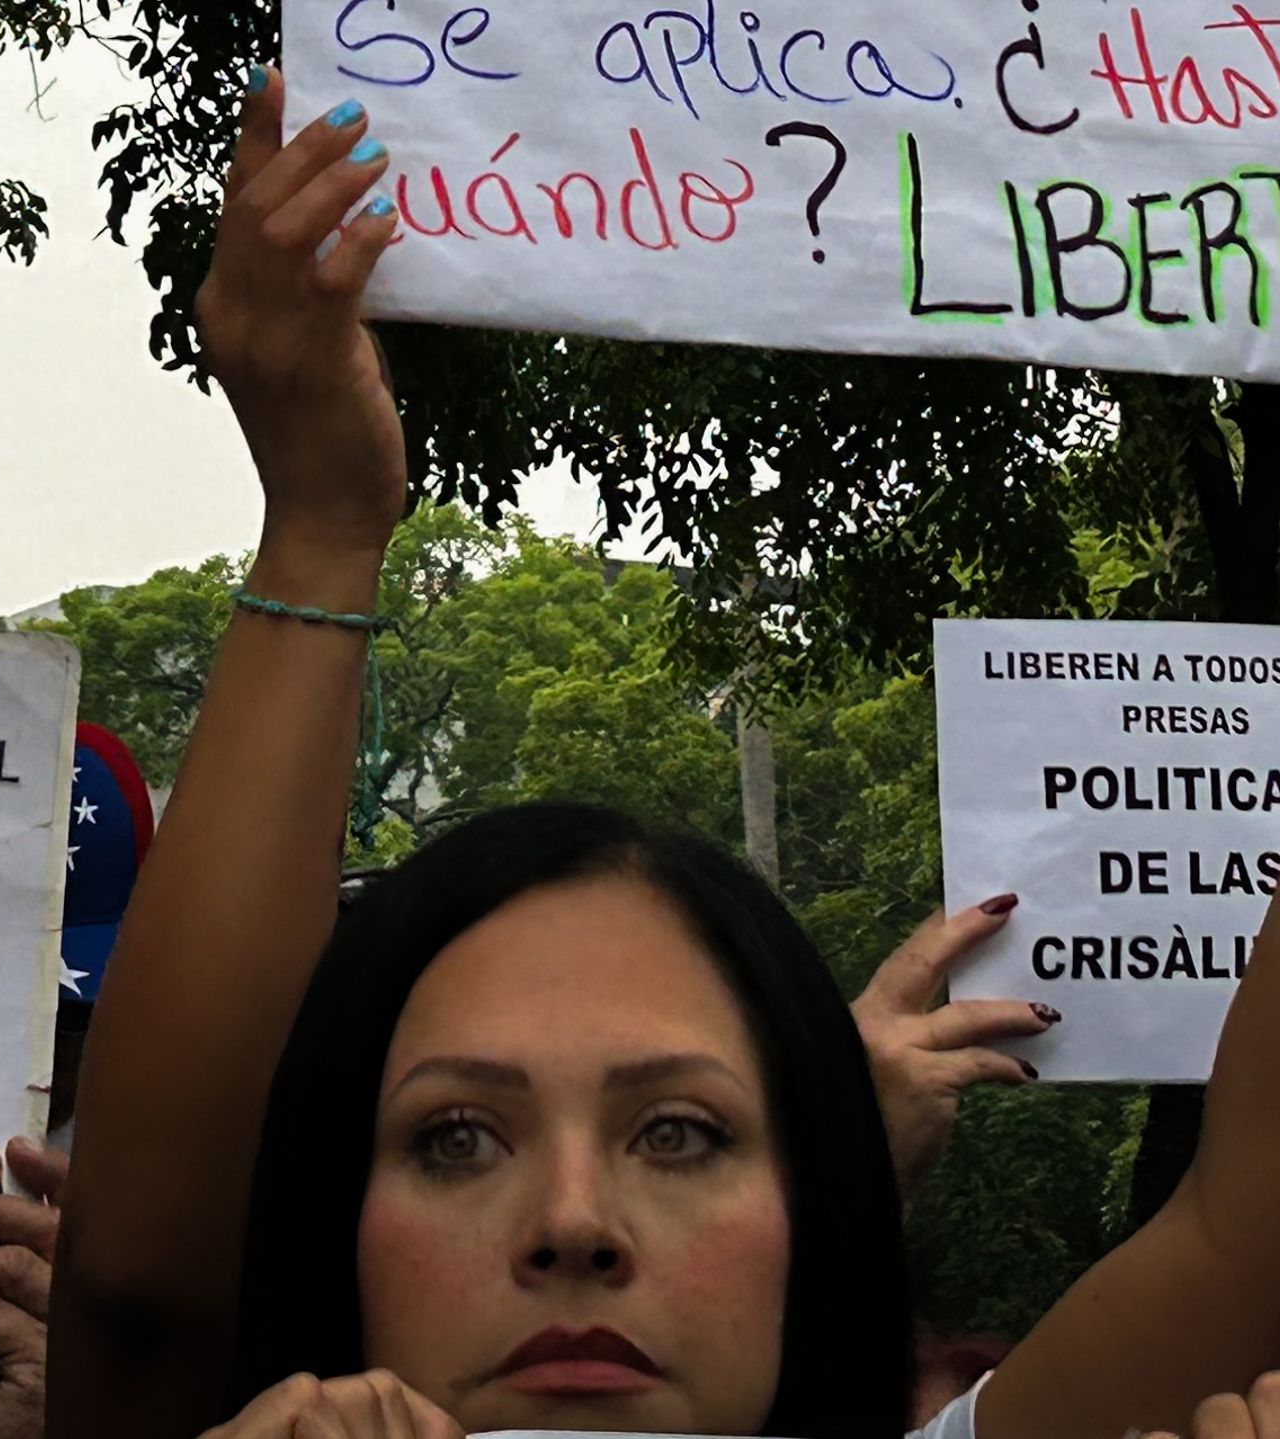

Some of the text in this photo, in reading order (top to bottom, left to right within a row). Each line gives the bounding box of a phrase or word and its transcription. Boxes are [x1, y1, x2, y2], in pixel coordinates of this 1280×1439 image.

[338, 121, 848, 263] uándo?
[983, 650, 1140, 681] LIBEREN
[1152, 653, 1175, 682] A
[1122, 705, 1251, 735] PRESAS
[1100, 852, 1169, 895] DE
[1031, 924, 1258, 980] CRISÀLI
